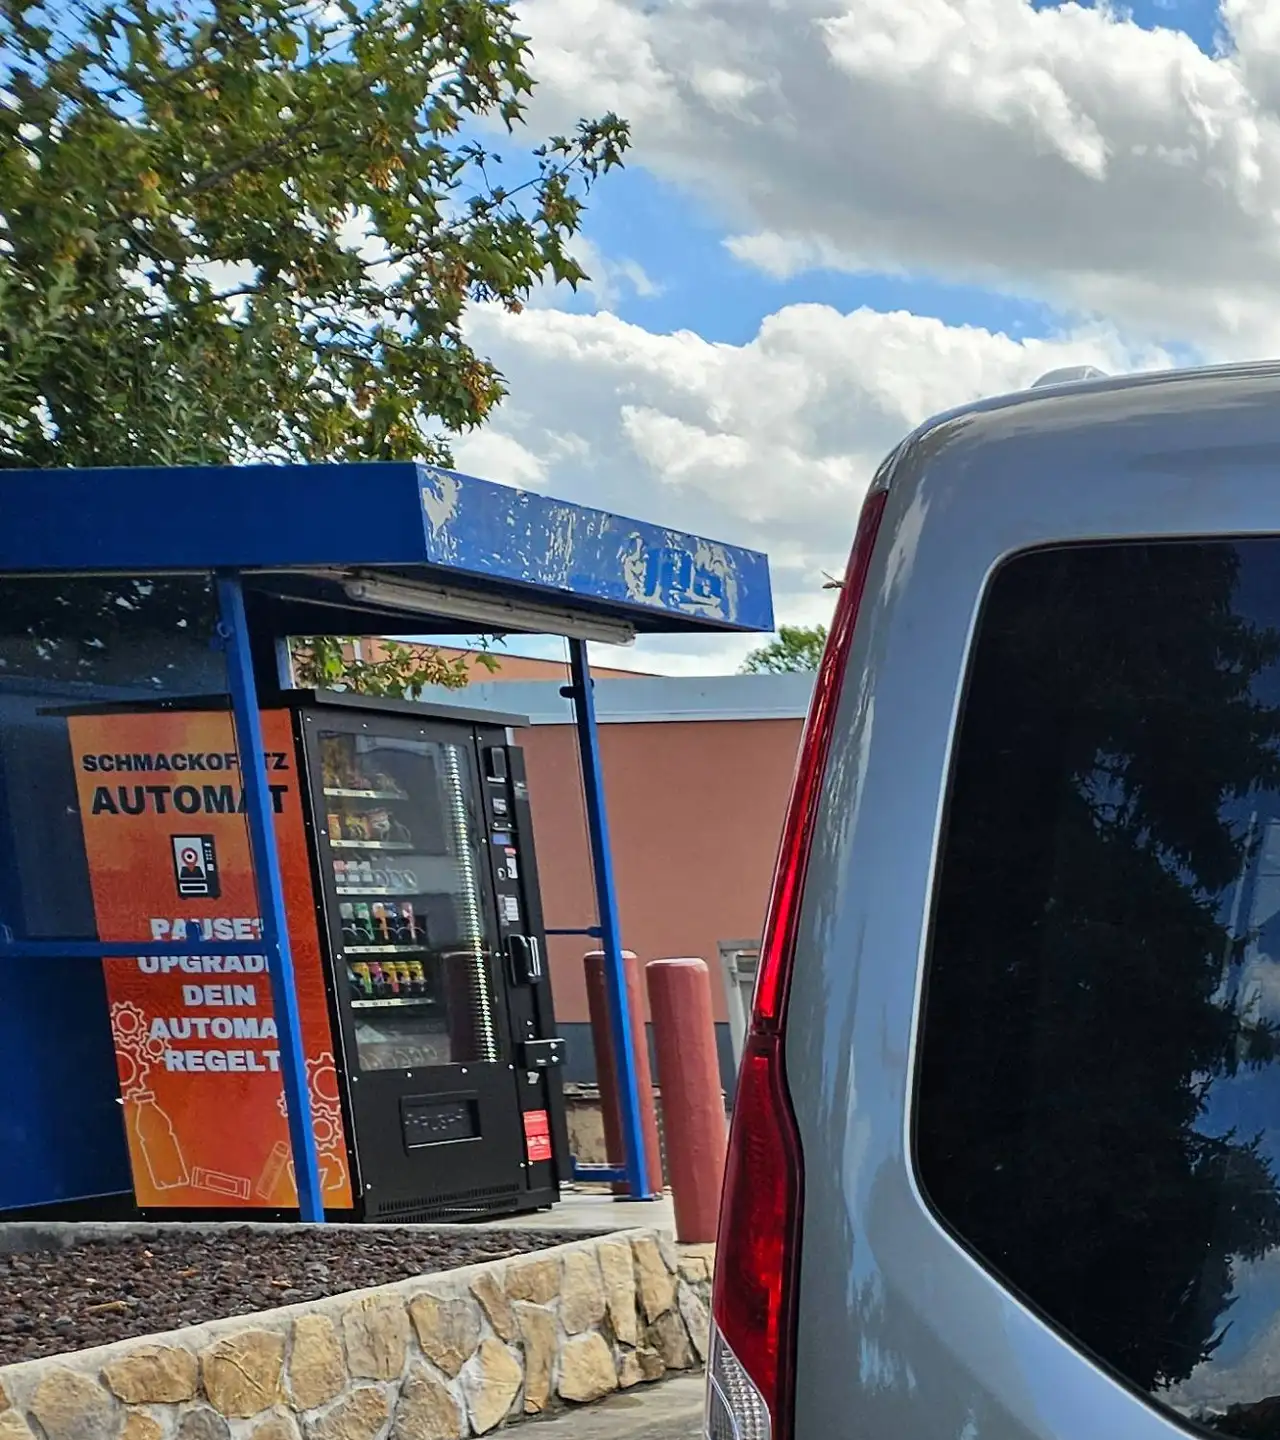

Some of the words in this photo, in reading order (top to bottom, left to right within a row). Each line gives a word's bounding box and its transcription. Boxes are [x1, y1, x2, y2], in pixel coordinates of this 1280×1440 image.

[82, 752, 290, 771] SCHMACKOFZ
[137, 955, 270, 974] UPGRAD
[182, 984, 257, 1007] DEIN
